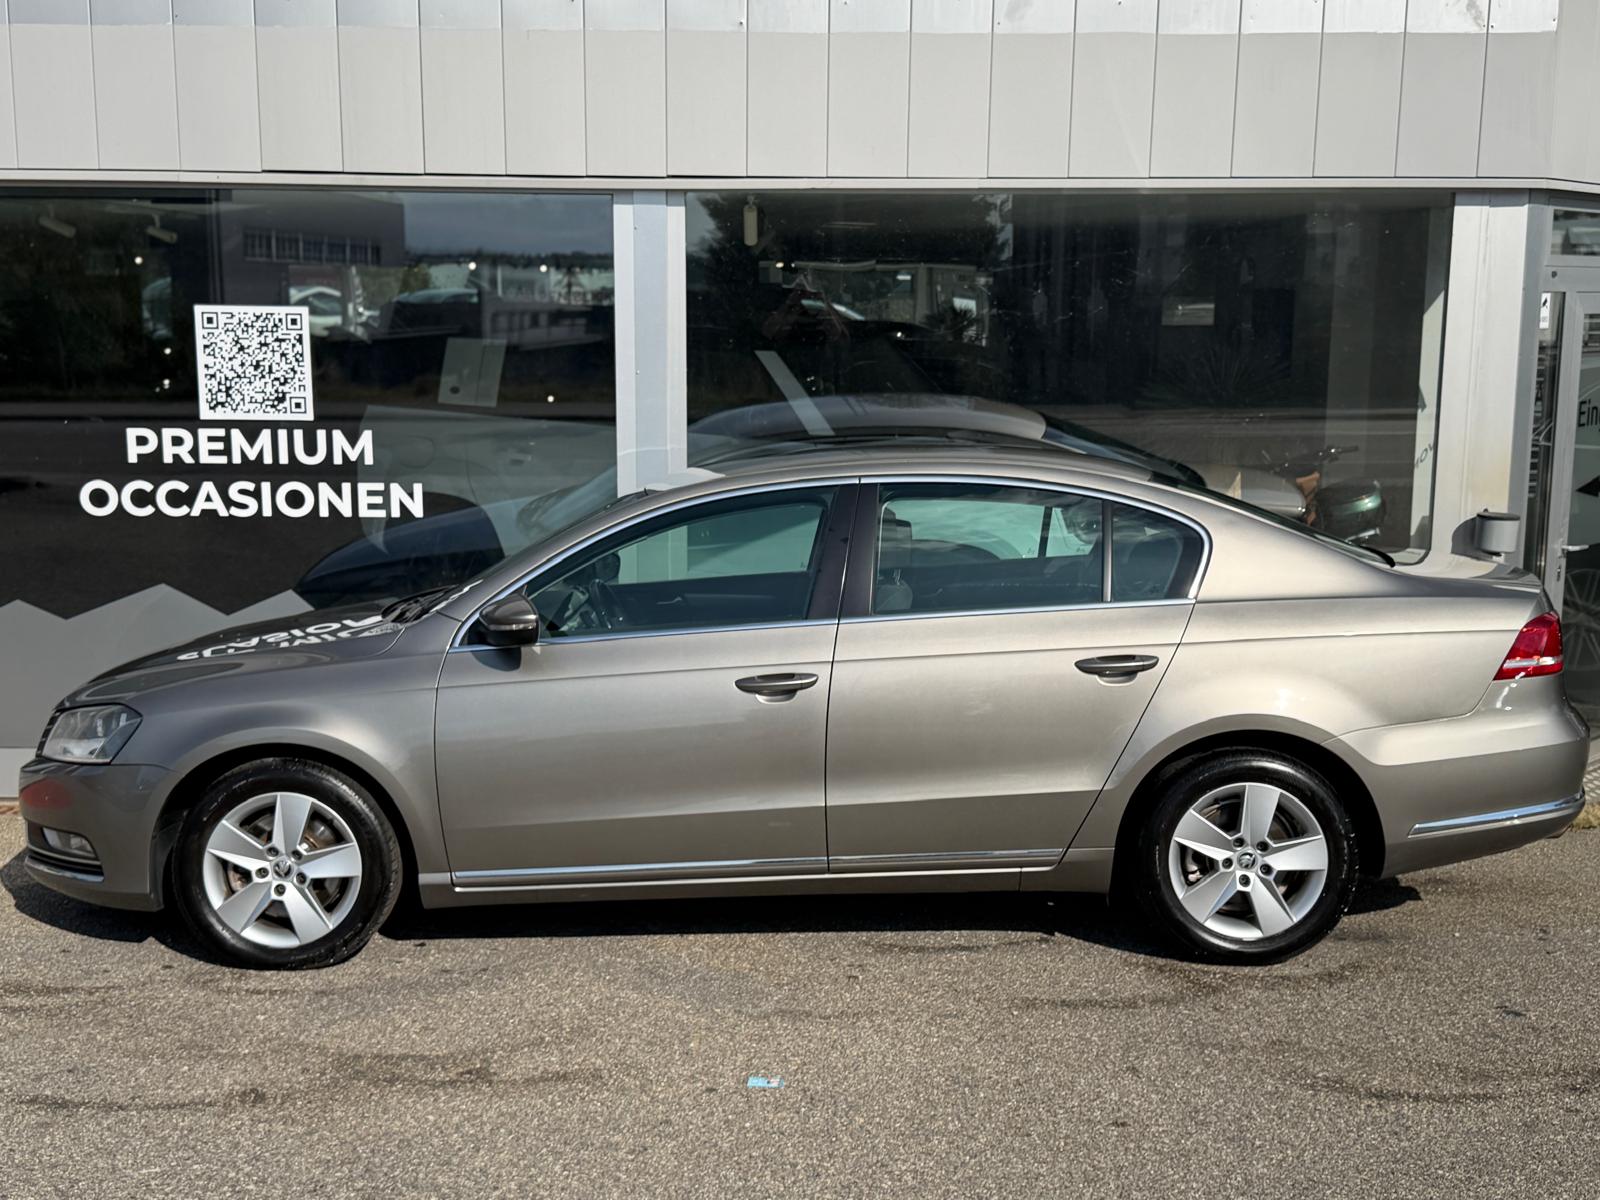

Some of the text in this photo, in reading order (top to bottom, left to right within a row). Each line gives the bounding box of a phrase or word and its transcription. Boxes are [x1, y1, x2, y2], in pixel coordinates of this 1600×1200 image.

[1578, 399, 1600, 428] Ein
[125, 427, 374, 466] PREMIUM
[79, 479, 424, 518] OCCASIONEN
